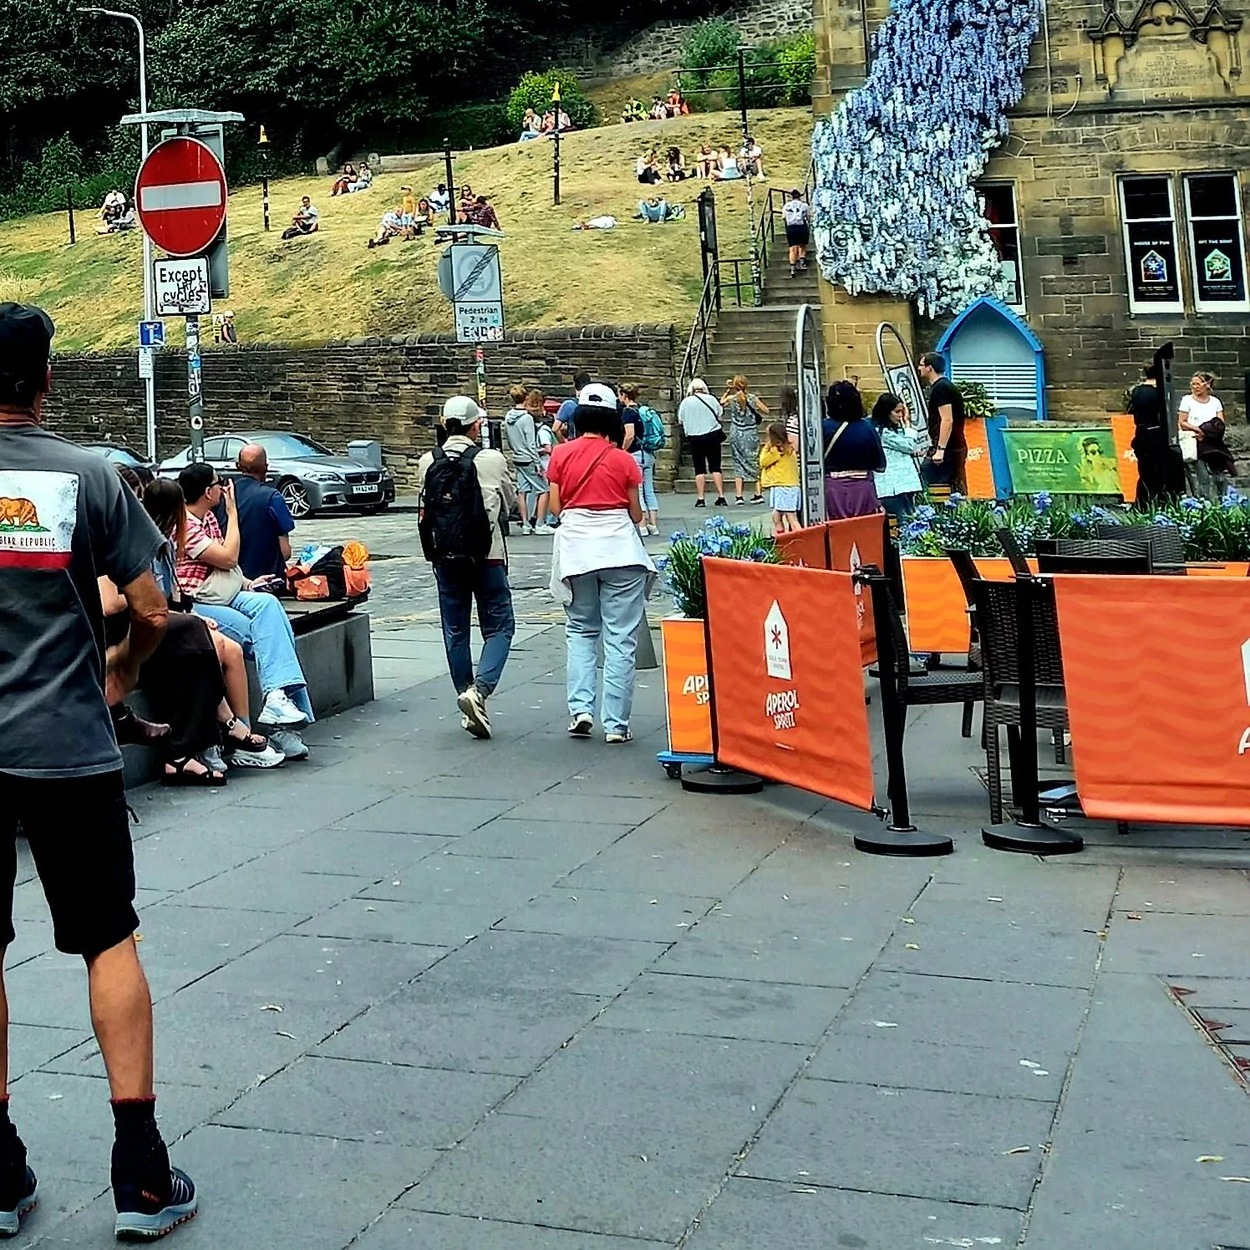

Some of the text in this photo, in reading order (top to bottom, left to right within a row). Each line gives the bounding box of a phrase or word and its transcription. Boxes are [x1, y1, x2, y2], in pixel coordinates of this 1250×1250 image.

[160, 266, 202, 284] Except
[459, 306, 499, 315] Pedestrian
[470, 315, 488, 324] Zne
[1016, 448, 1069, 464] PIZZA
[19, 537, 56, 547] REPUBLIC
[765, 689, 800, 717] APEROL
[773, 712, 796, 730] SPRITZ
